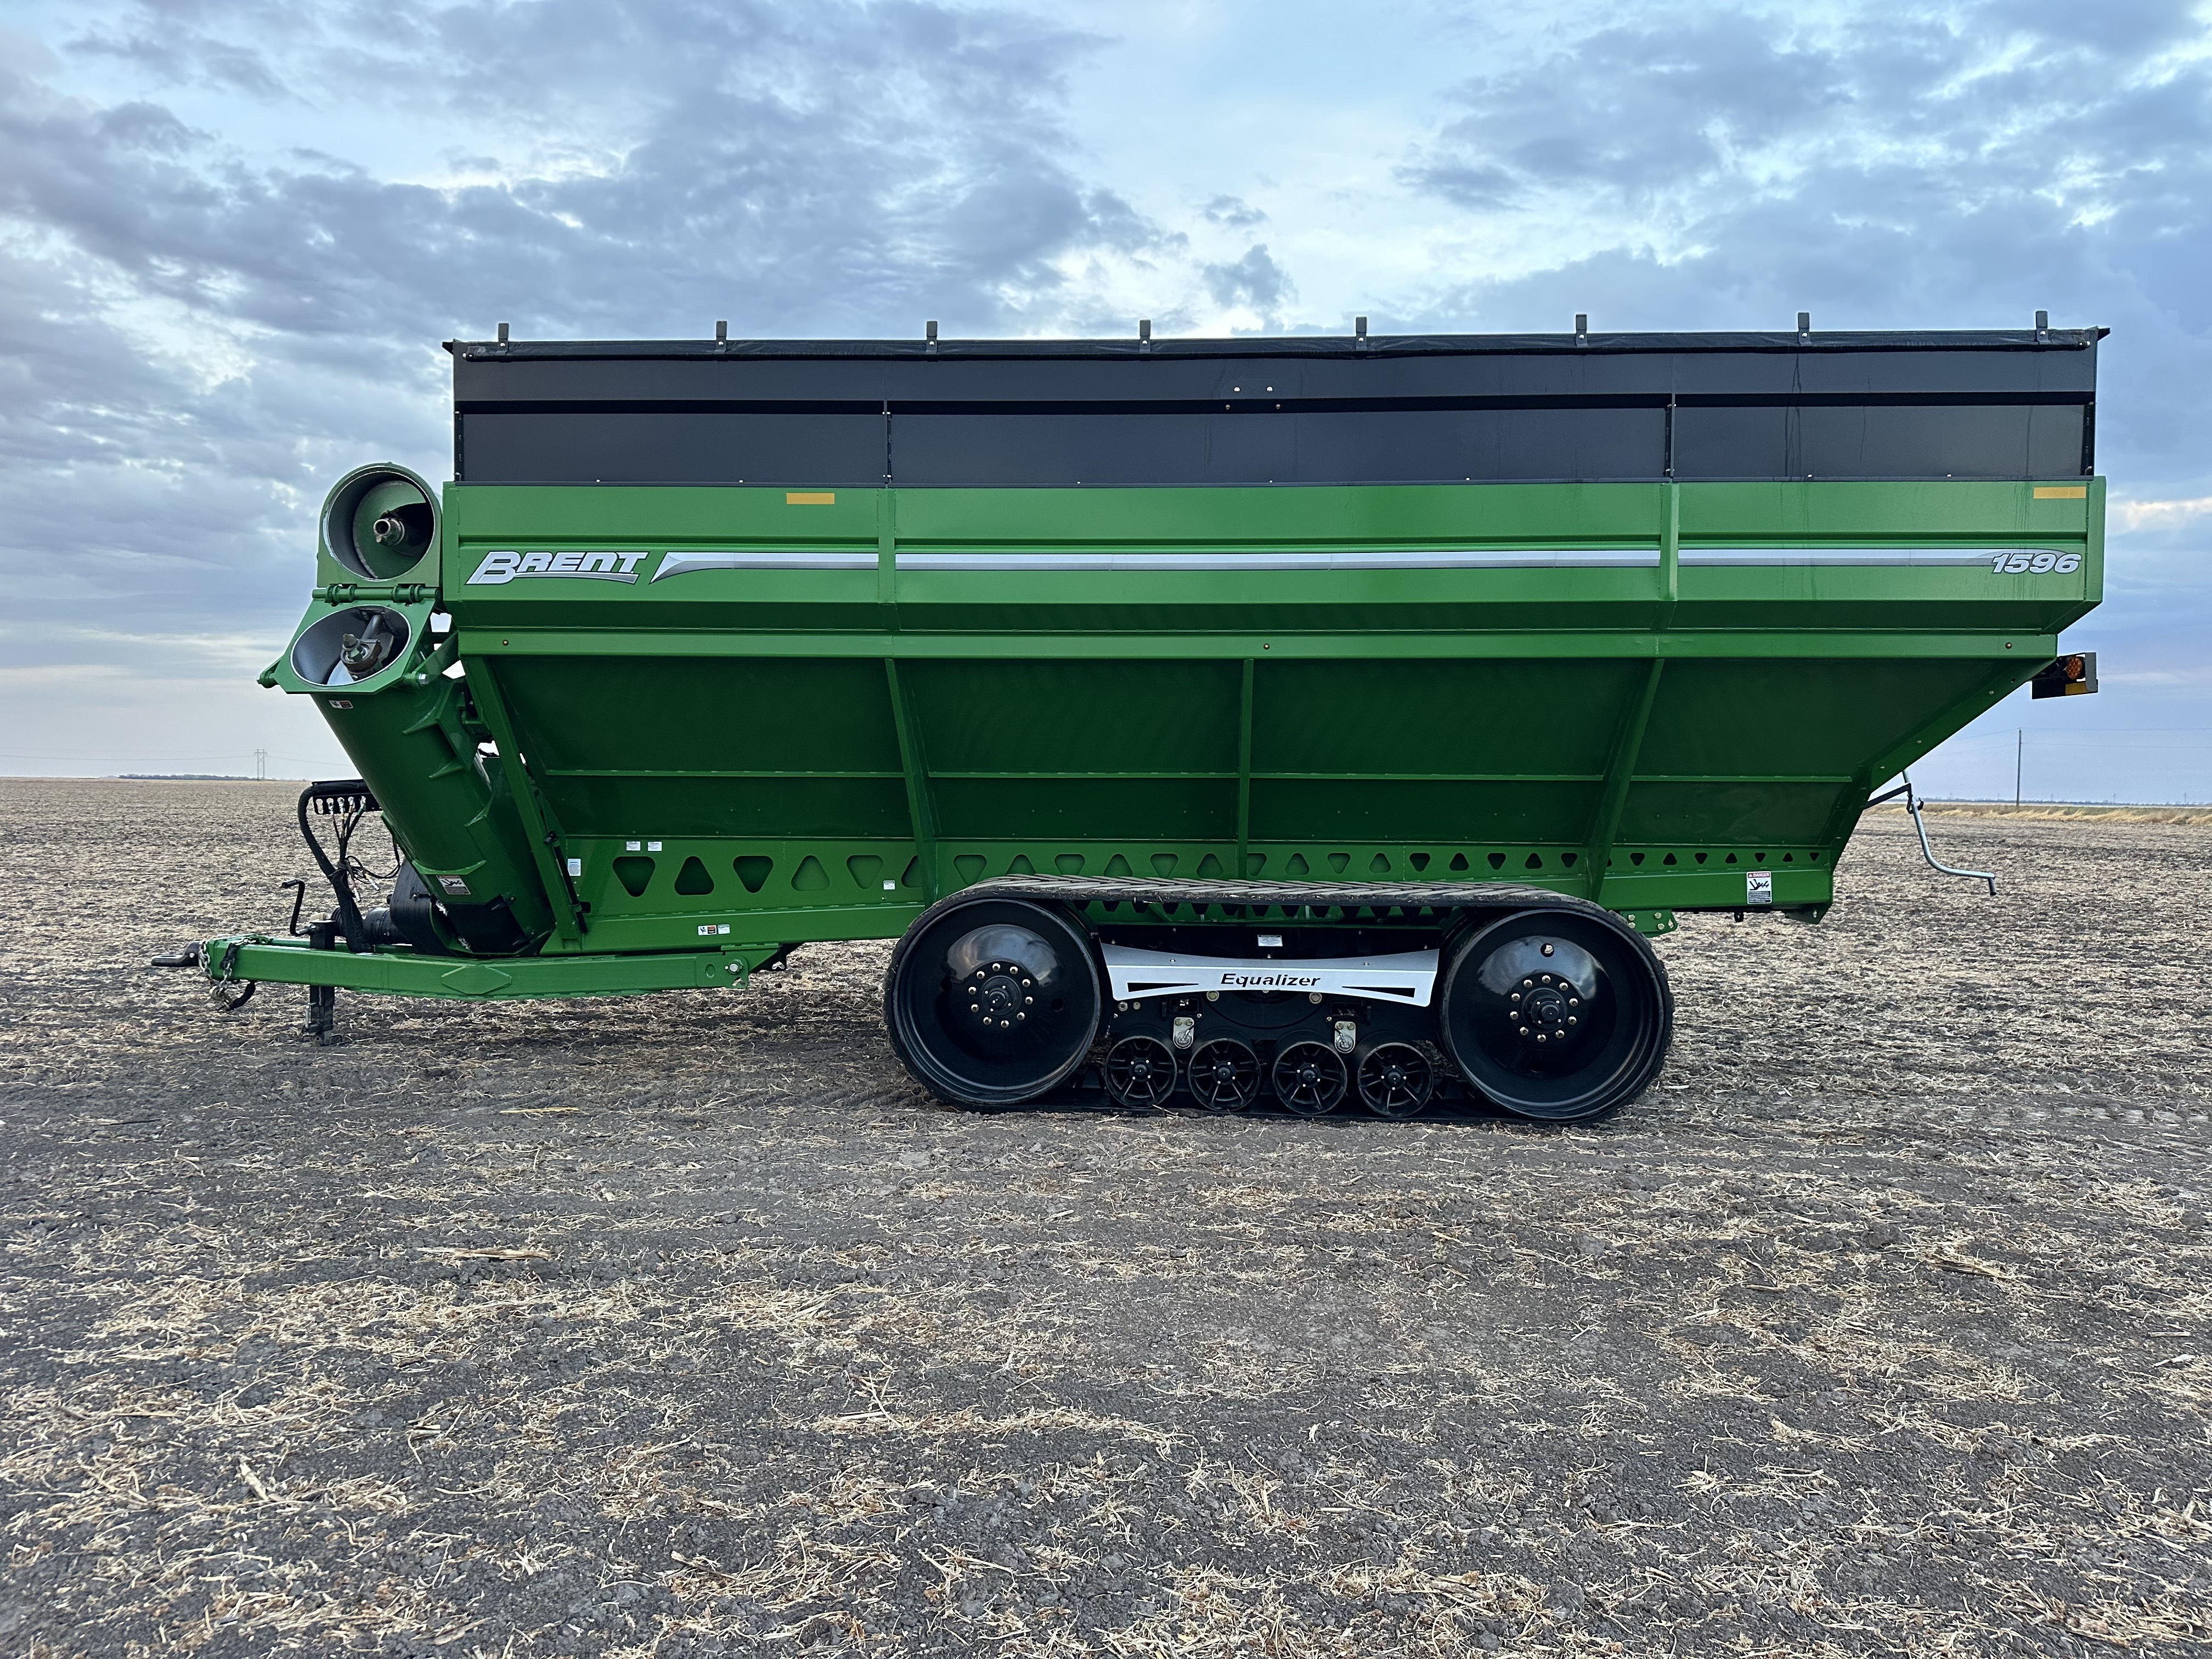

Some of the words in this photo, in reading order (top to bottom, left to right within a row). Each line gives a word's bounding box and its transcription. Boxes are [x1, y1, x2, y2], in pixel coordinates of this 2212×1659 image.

[465, 551, 650, 584] BRENT
[1991, 553, 2082, 574] 1596
[1221, 973, 1321, 988] Equalizer
